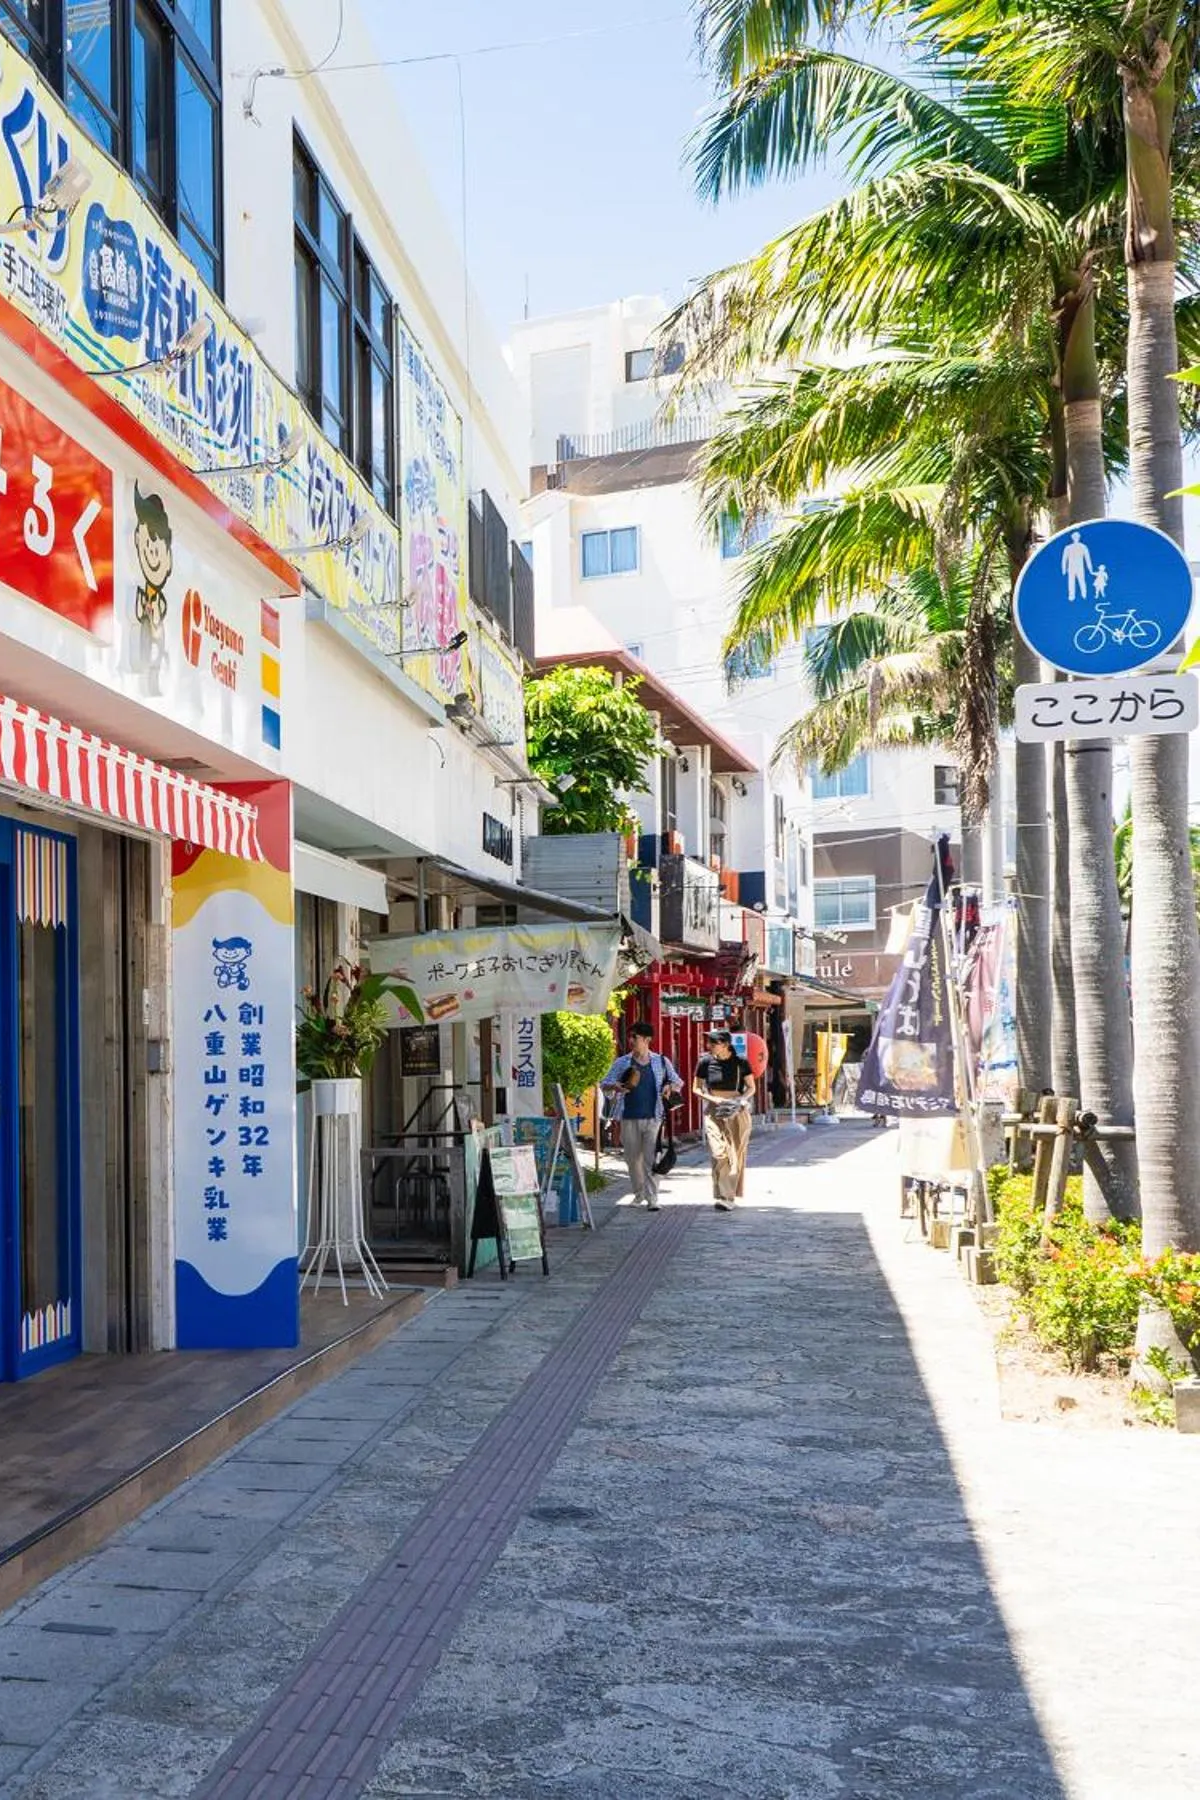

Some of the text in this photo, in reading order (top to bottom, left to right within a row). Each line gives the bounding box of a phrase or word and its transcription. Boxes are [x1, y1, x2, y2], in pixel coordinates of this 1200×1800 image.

[203, 603, 244, 656] Yaeyama
[211, 651, 237, 692] Genki
[1031, 688, 1185, 728] ここから
[516, 1016, 536, 1089] ガラス館
[237, 1001, 270, 1179] 創業昭和32年
[203, 1003, 231, 1242] 八重山ゲンキ乳業
